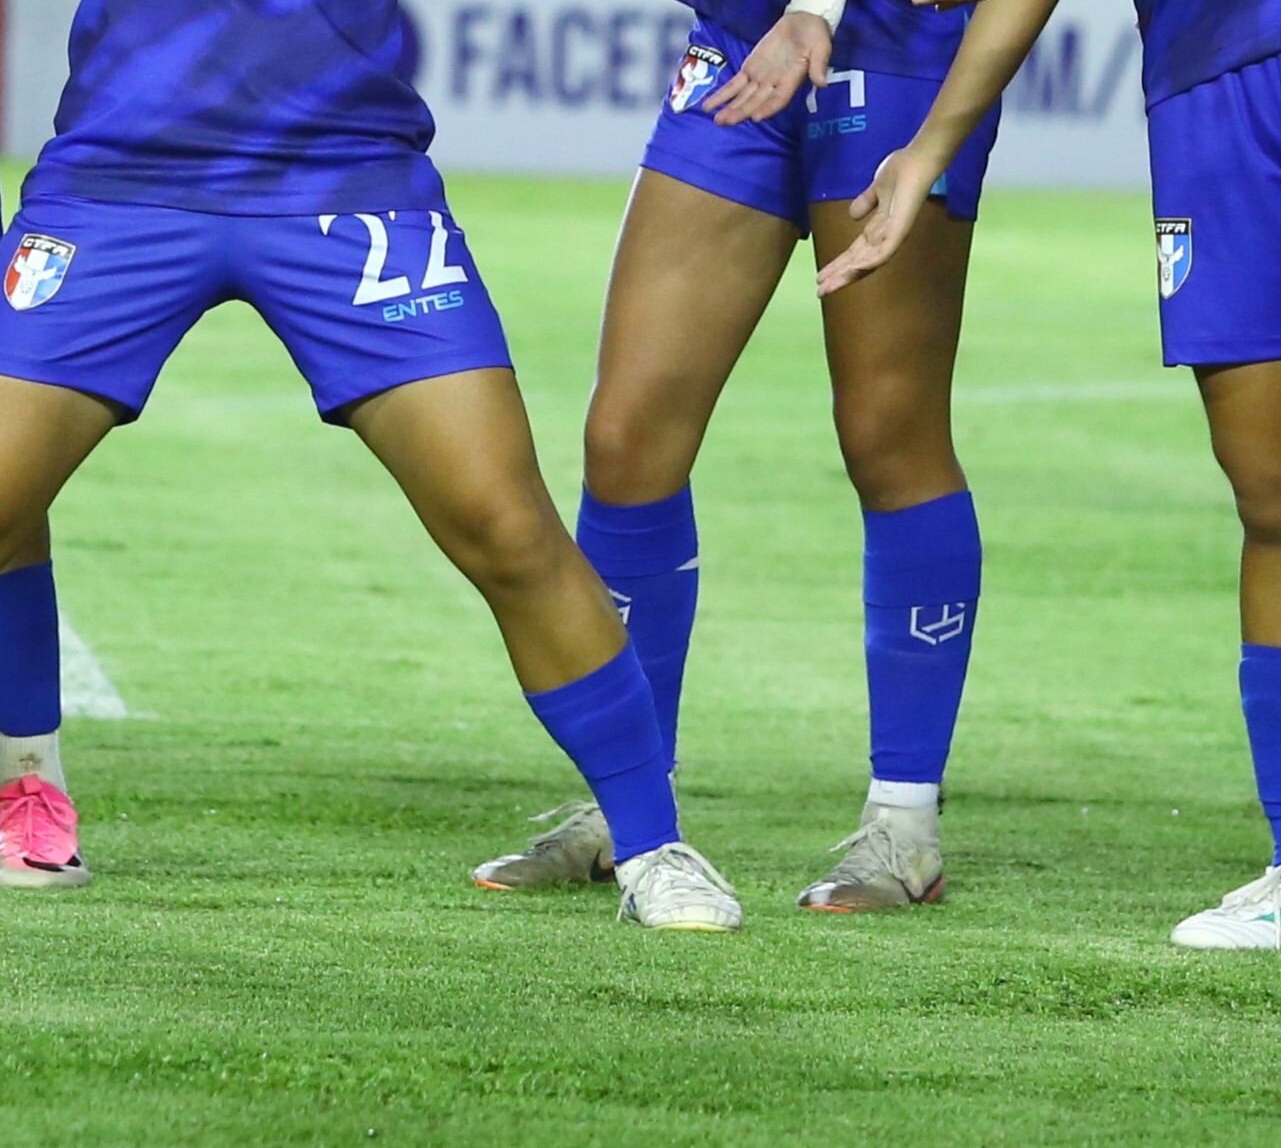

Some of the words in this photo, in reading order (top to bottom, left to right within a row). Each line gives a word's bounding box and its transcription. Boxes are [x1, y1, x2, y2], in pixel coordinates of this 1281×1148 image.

[689, 46, 723, 65] CTFA
[808, 114, 866, 139] ENTES
[23, 238, 68, 257] CTFA
[319, 210, 468, 305] 22
[383, 290, 464, 322] ENTES
